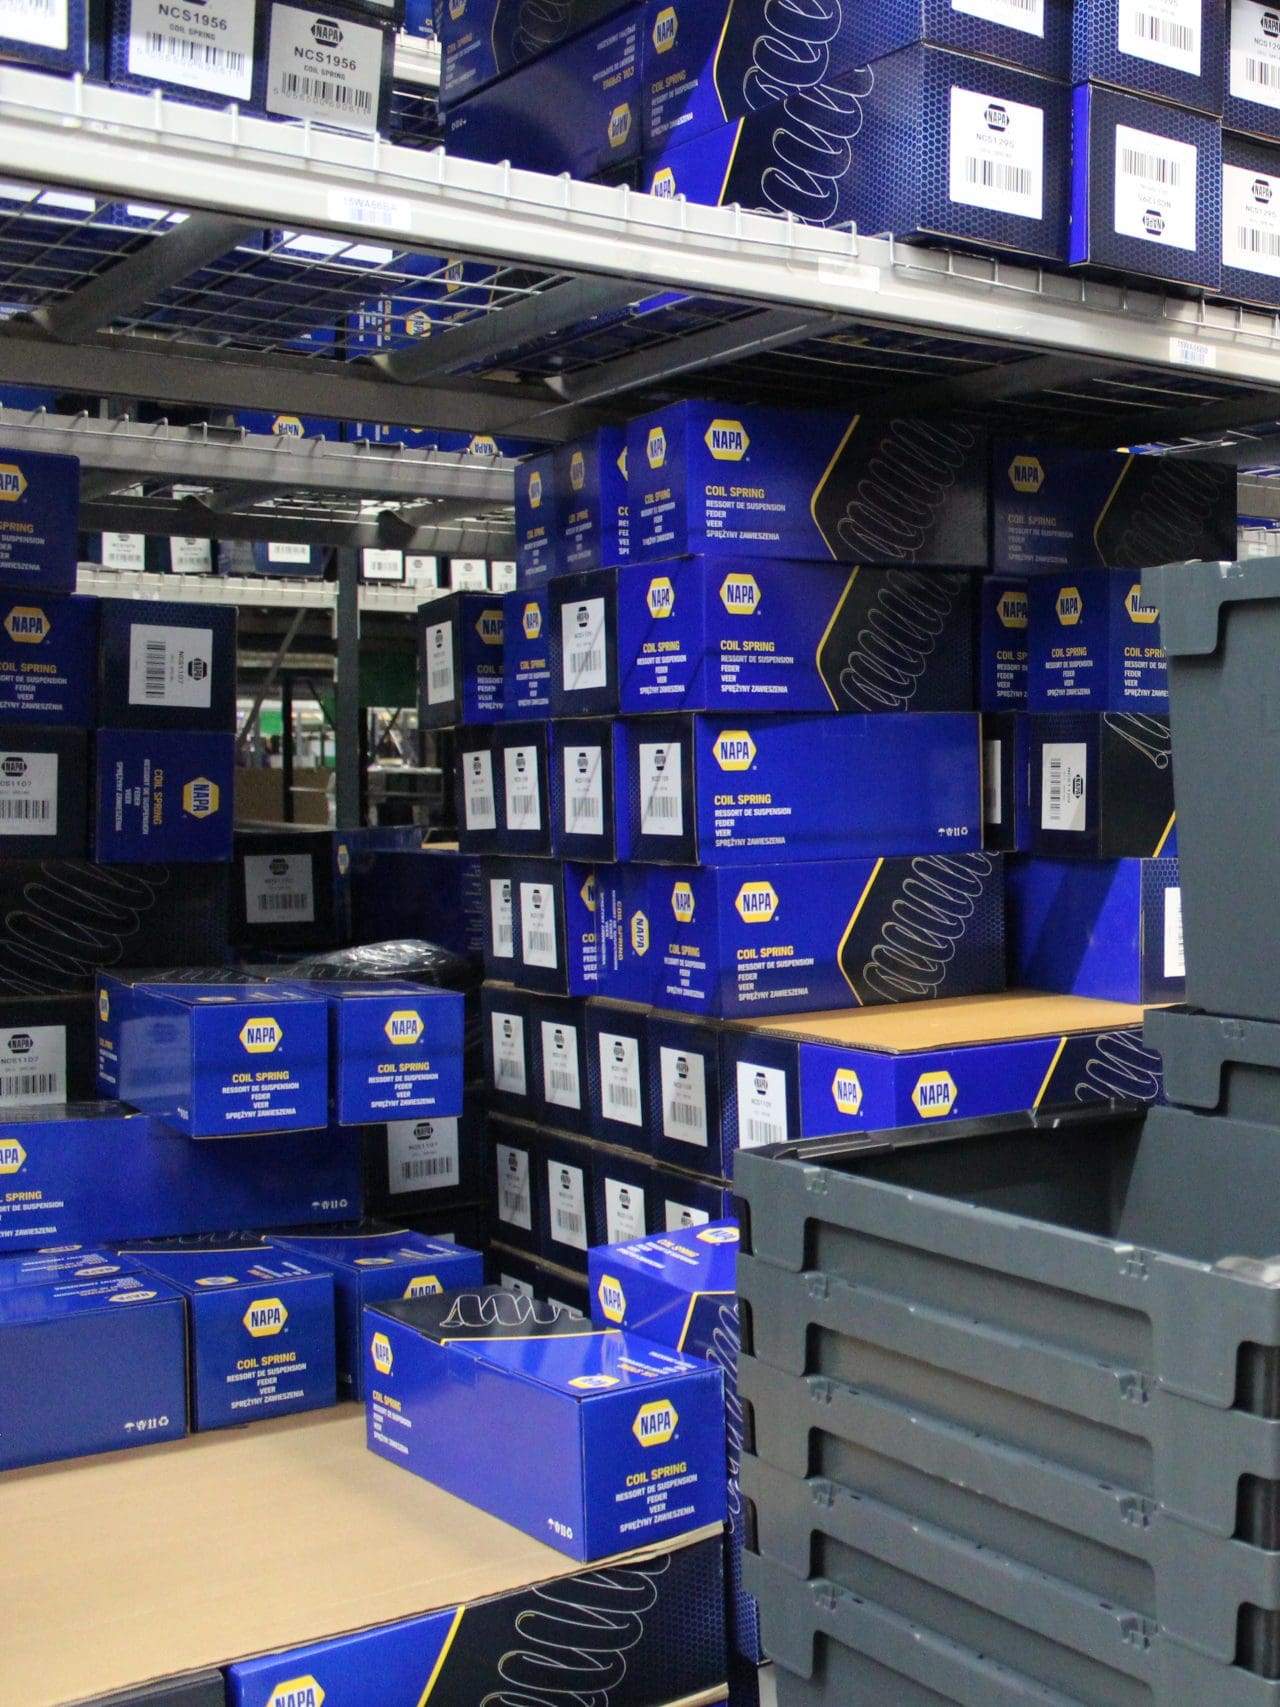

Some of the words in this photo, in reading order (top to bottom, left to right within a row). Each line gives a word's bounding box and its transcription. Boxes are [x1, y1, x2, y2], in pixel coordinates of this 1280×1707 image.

[158, 4, 227, 31] NCS1956
[170, 24, 186, 33] COIL
[189, 28, 215, 40] SPRING
[656, 17, 674, 43] NAPA
[1264, 19, 1279, 32] NAPA
[315, 25, 339, 42] NAPA
[294, 46, 356, 70] NCS1956
[304, 65, 319, 74] COIL
[322, 69, 345, 80] SPRING
[988, 111, 1005, 125] NAPA
[977, 133, 1015, 148] NCS1295
[1255, 185, 1269, 198] NAPA
[1246, 205, 1276, 218] NCS1295
[1145, 215, 1161, 228] NAPA
[278, 423, 298, 436] NAPA
[713, 430, 742, 450] NAPA
[474, 442, 493, 454] NAPA
[651, 438, 663, 460] NAPA
[1015, 465, 1038, 483] NAPA
[706, 486, 727, 496] COIL
[730, 488, 764, 498] SPRING
[706, 500, 734, 508] RESSORT
[747, 503, 785, 511] SUSPENSION
[706, 510, 726, 518] FEDER
[652, 588, 670, 608] NAPA
[727, 584, 754, 604] NAPA
[1003, 602, 1027, 617] NAPA
[1060, 598, 1078, 615] NAPA
[12, 616, 43, 633] NAPA
[643, 643, 656, 653] COIL
[658, 641, 680, 652] SPRING
[720, 640, 740, 650] COIL
[743, 641, 775, 652] SPRING
[1052, 649, 1064, 658] COIL
[1066, 647, 1087, 657] SPRING
[1124, 647, 1142, 657] COIL
[758, 656, 794, 664] SUSPENSION
[997, 651, 1014, 660] COIL
[21, 663, 56, 673] SPRING
[27, 676, 67, 684] SUSPENSION
[721, 742, 749, 760] NAPA
[5, 760, 23, 773] NAPA
[155, 769, 163, 790] COIL
[193, 784, 209, 811] NAPA
[715, 796, 736, 805] COIL
[738, 794, 771, 804] SPRING
[154, 792, 163, 824] SPRING
[715, 819, 735, 827] FEDER
[676, 893, 690, 911] NAPA
[743, 893, 771, 912] NAPA
[636, 918, 644, 948] NAPA
[737, 949, 758, 960] COIL
[760, 945, 793, 957] SPRING
[738, 962, 765, 971] RESSORT
[776, 958, 814, 968] SUSPENSION
[738, 973, 757, 981] FEDER
[739, 983, 754, 991] VEER
[392, 1020, 417, 1036] NAPA
[248, 1027, 275, 1044] NAPA
[12, 1040, 30, 1048] NAPA
[378, 1064, 396, 1073] COIL
[399, 1062, 430, 1071] SPRING
[233, 1073, 253, 1083] COIL
[256, 1071, 289, 1081] SPRING
[222, 1086, 250, 1094] RESSORT
[261, 1083, 299, 1091] SUSPENSION
[838, 1080, 857, 1102] NAPA
[920, 1083, 949, 1106] NAPA
[6, 1191, 42, 1202] SPRING
[23, 1201, 64, 1210] SUSPENSION
[411, 1285, 437, 1297] NAPA
[603, 1286, 621, 1312] NAPA
[251, 1308, 280, 1327] NAPA
[376, 1342, 389, 1365] NAPA
[237, 1359, 259, 1370] COIL
[262, 1352, 296, 1366] SPRING
[227, 1372, 256, 1382] RESSORT
[267, 1363, 306, 1375] SUSPENSION
[257, 1377, 277, 1386] FEDER
[260, 1386, 275, 1394] VEER
[641, 1411, 670, 1435] NAPA
[626, 1472, 648, 1486] COIL
[651, 1462, 686, 1480] SPRING
[616, 1487, 645, 1502] RESSORT
[647, 1485, 655, 1493] DE
[657, 1474, 697, 1490] SUSPENSION
[647, 1492, 667, 1504] FEDER
[649, 1503, 666, 1513] VEER
